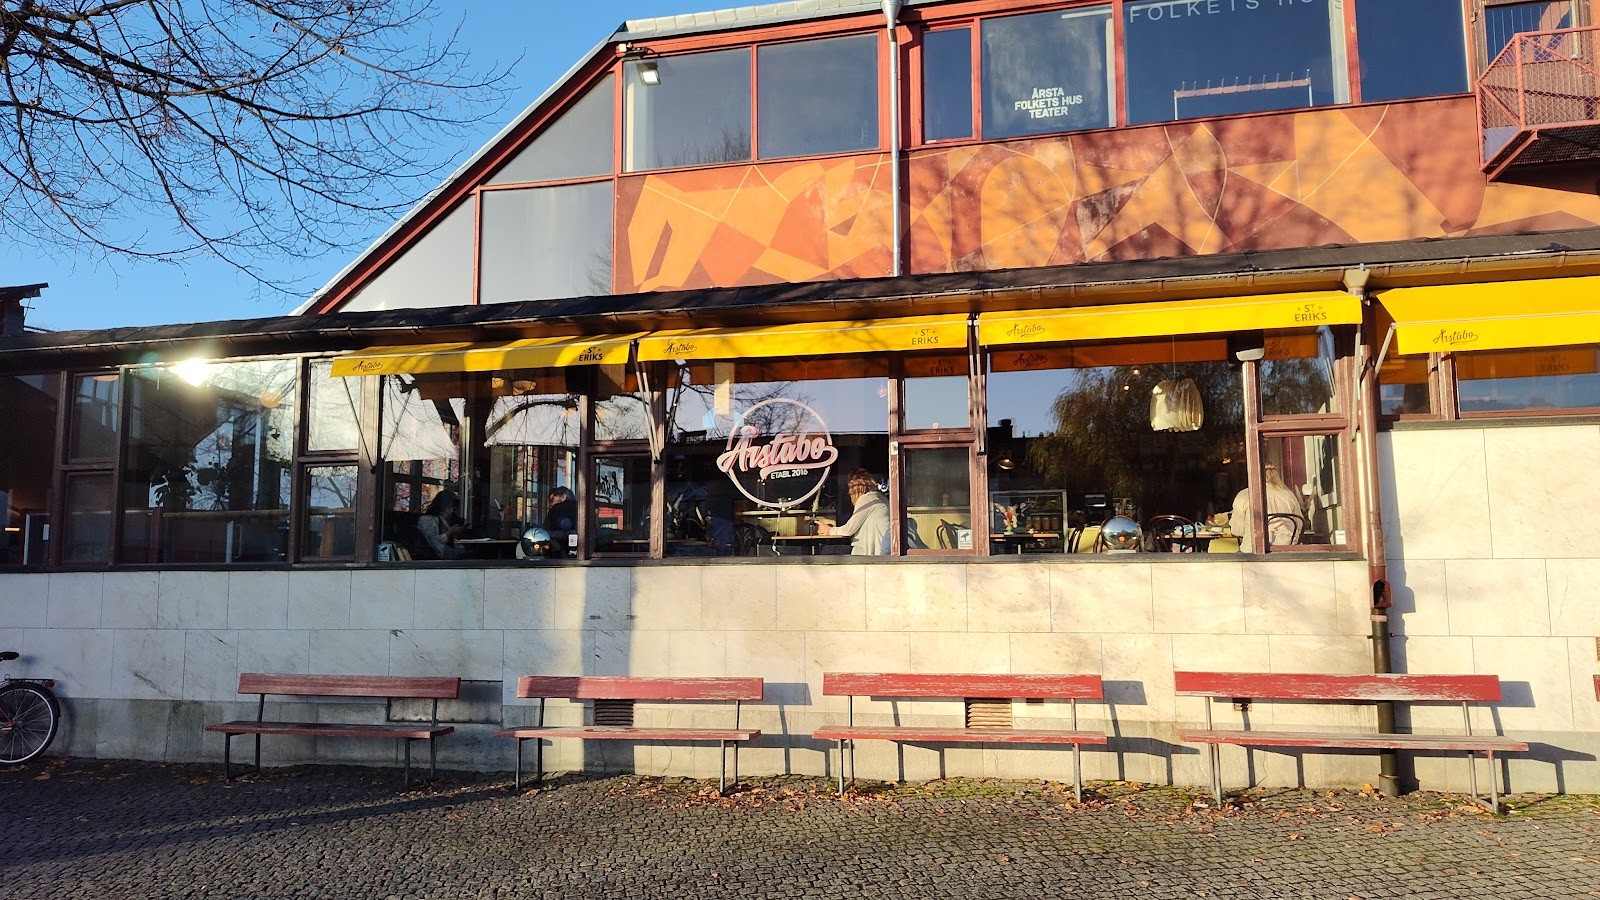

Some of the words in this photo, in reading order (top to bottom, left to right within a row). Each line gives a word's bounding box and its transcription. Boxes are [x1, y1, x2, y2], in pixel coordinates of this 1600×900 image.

[1031, 87, 1065, 99] ÅRSTA
[1014, 97, 1060, 111] FOLKETS
[1061, 94, 1083, 106] HUS
[1028, 106, 1069, 119] TEATER
[1294, 312, 1327, 322] ERIKS
[911, 336, 939, 345] ERIKS
[578, 353, 603, 362] ERIKS
[770, 470, 791, 480] ETABL
[791, 469, 808, 477] 2016
